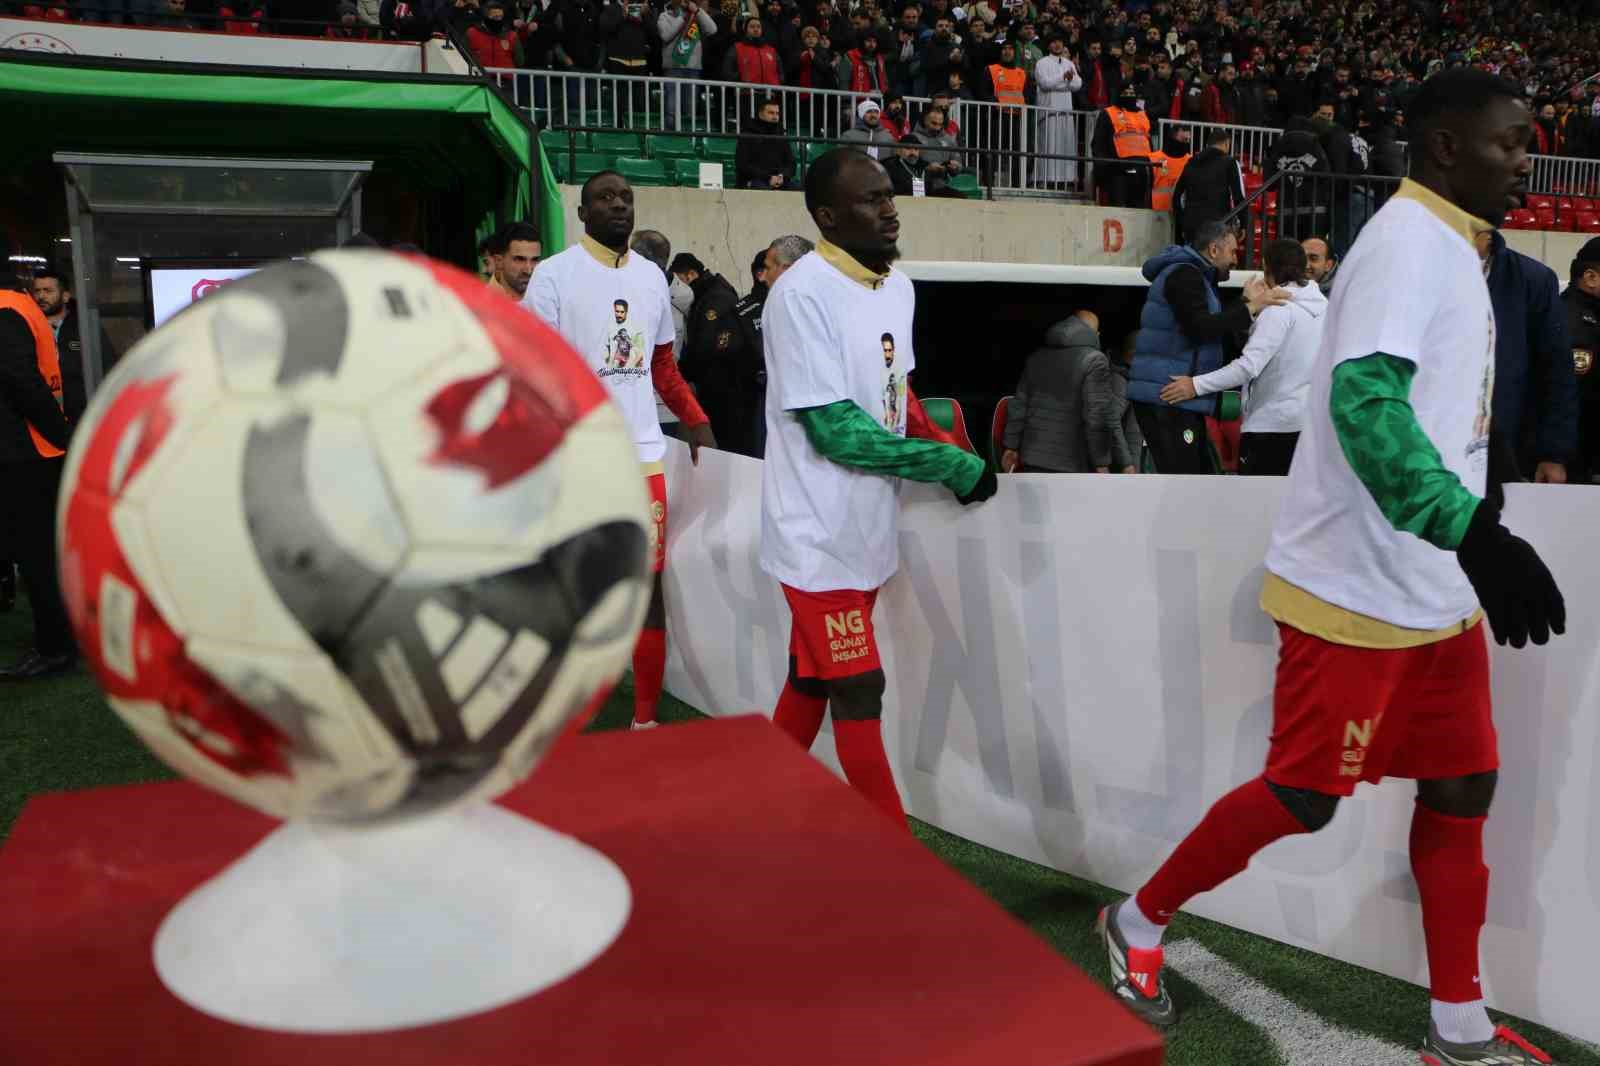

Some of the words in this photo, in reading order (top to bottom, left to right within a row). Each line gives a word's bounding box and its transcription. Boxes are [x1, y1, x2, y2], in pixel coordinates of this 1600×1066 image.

[1103, 218, 1124, 253] D
[825, 610, 865, 639] NG
[831, 635, 866, 650] GÜNAY
[1343, 719, 1377, 747] N
